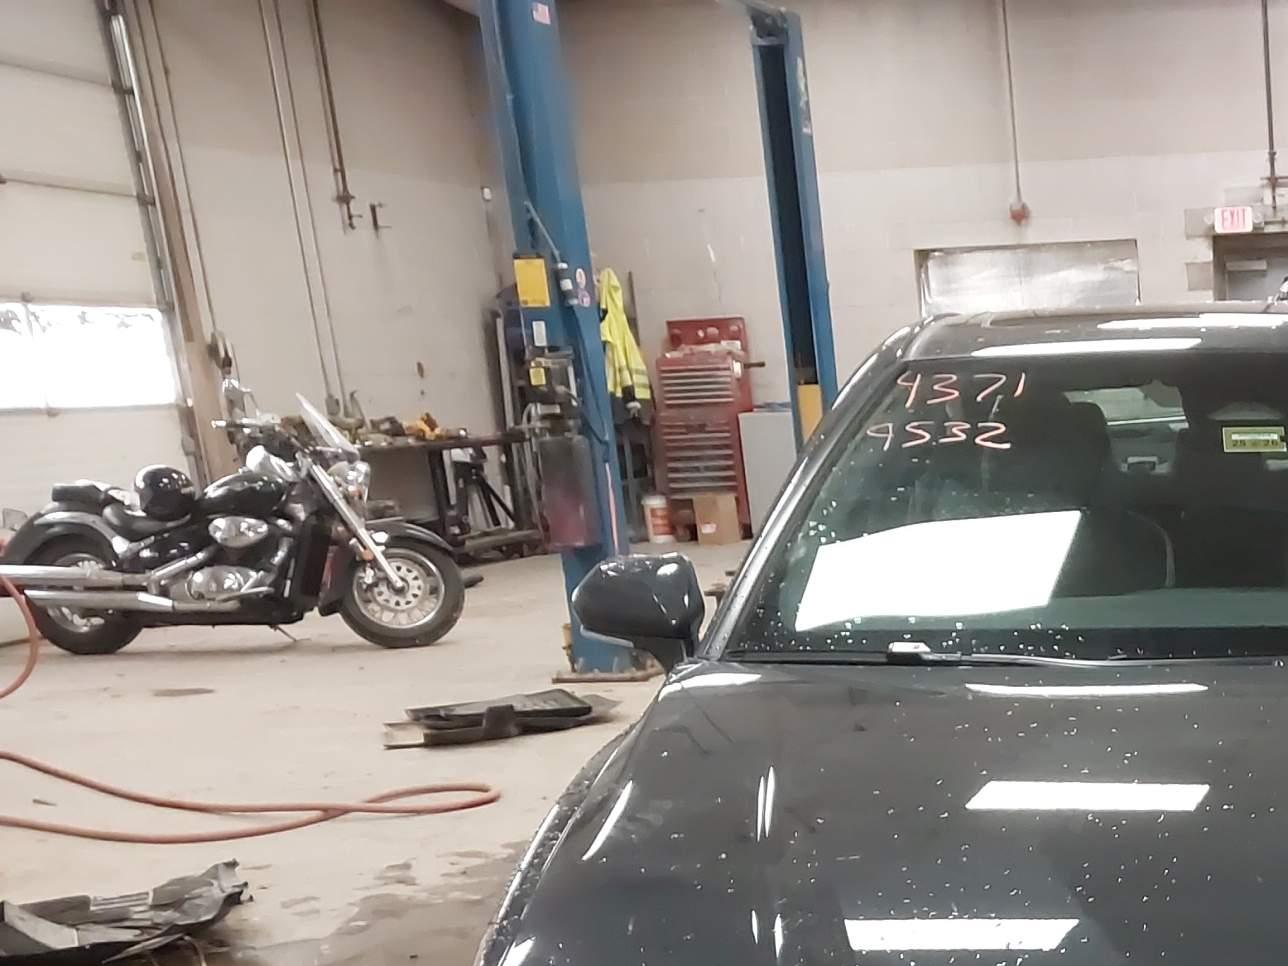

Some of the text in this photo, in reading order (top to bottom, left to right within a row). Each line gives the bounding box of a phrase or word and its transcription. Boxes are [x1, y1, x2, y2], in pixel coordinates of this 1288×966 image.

[1221, 208, 1247, 229] EXIT
[897, 371, 1026, 408] 4371
[866, 420, 1011, 451] 9532
